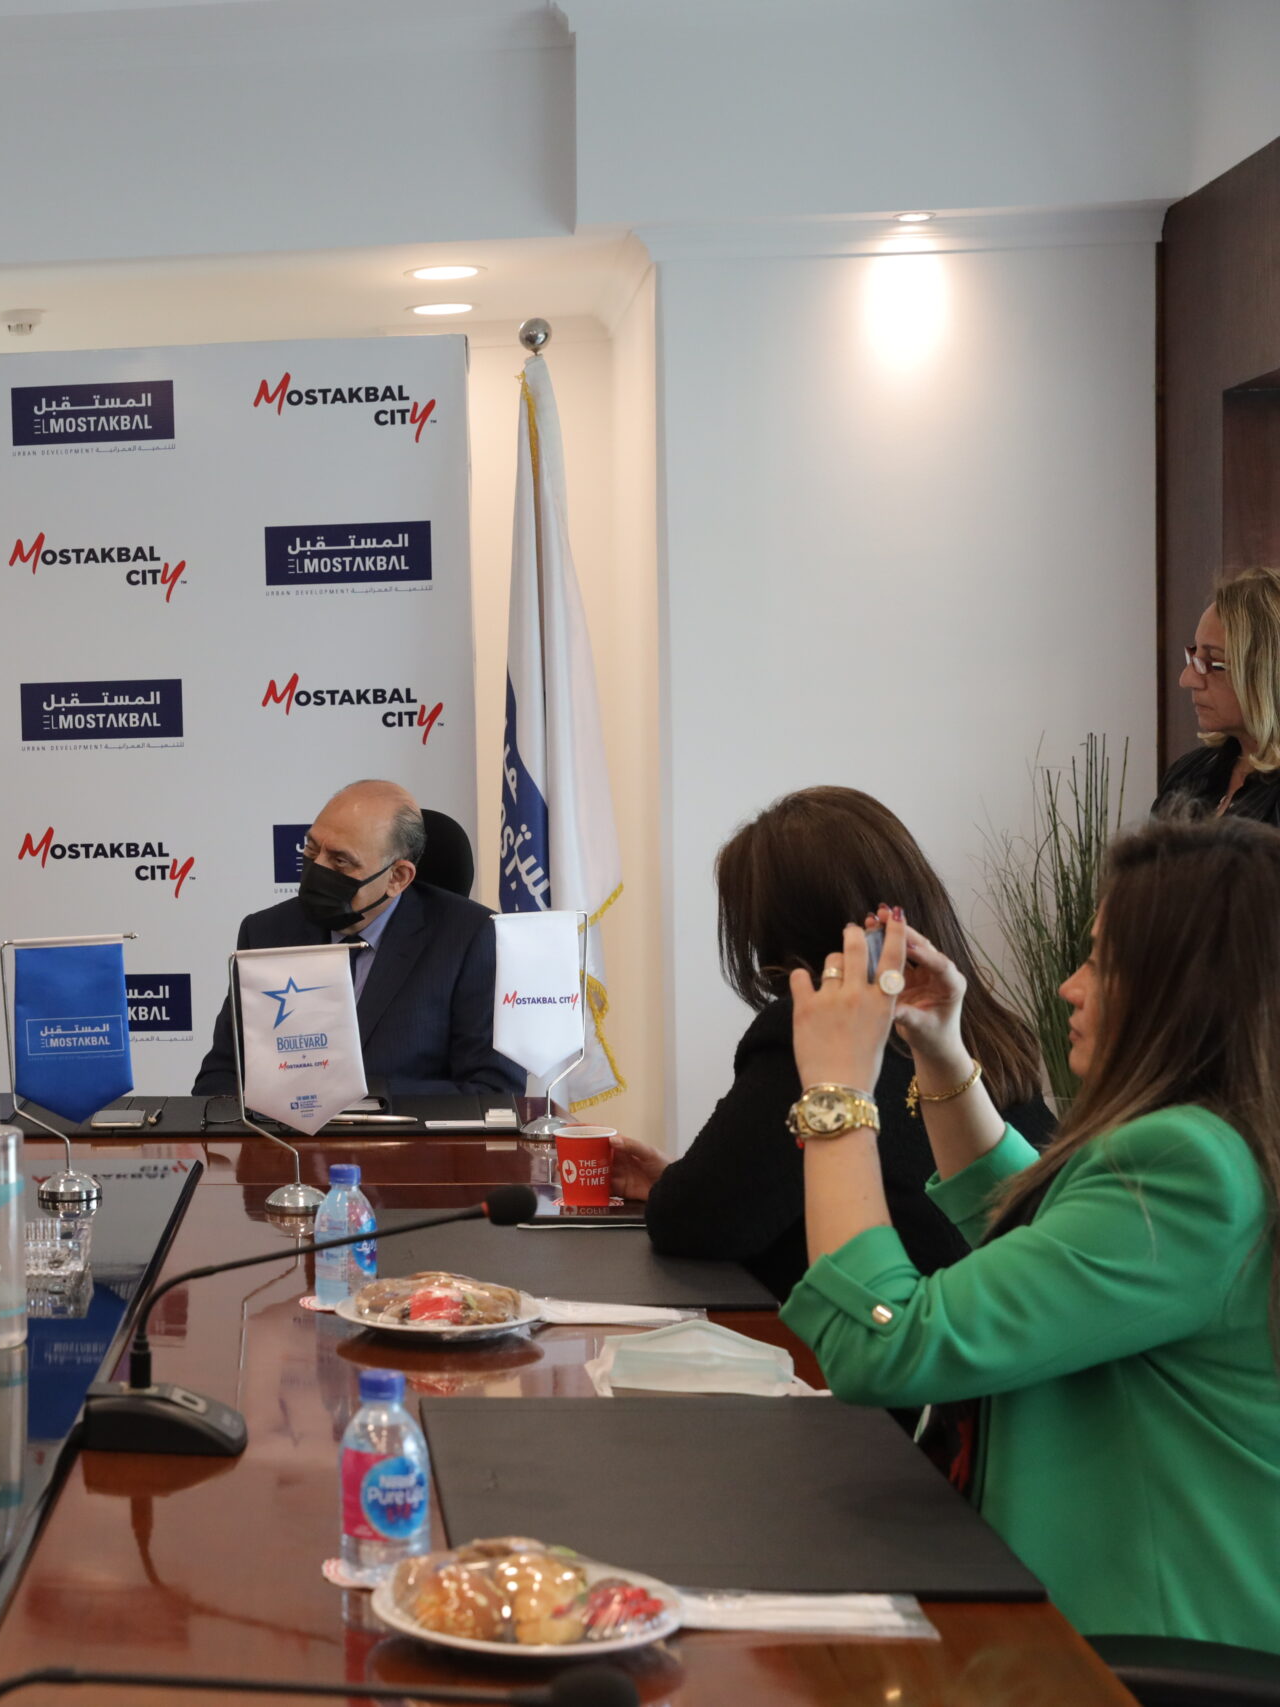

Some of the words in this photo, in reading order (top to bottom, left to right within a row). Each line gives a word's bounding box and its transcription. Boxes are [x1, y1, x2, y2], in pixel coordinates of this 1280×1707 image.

[254, 372, 409, 413] MOSTAKBAL
[32, 393, 153, 416] المستقبل
[9, 532, 160, 573] MOSTAKBAL
[286, 533, 409, 555] المستقبل
[41, 691, 160, 712] المستقبل
[262, 673, 417, 713] MOSTAKBAL
[18, 826, 169, 868] MOSTAKBAL
[502, 990, 557, 1009] MOSTAKBAL
[558, 993, 580, 1011] CITY
[276, 1033, 328, 1051] BOULEVARD
[579, 1159, 597, 1167] THE
[580, 1177, 606, 1186] TIME
